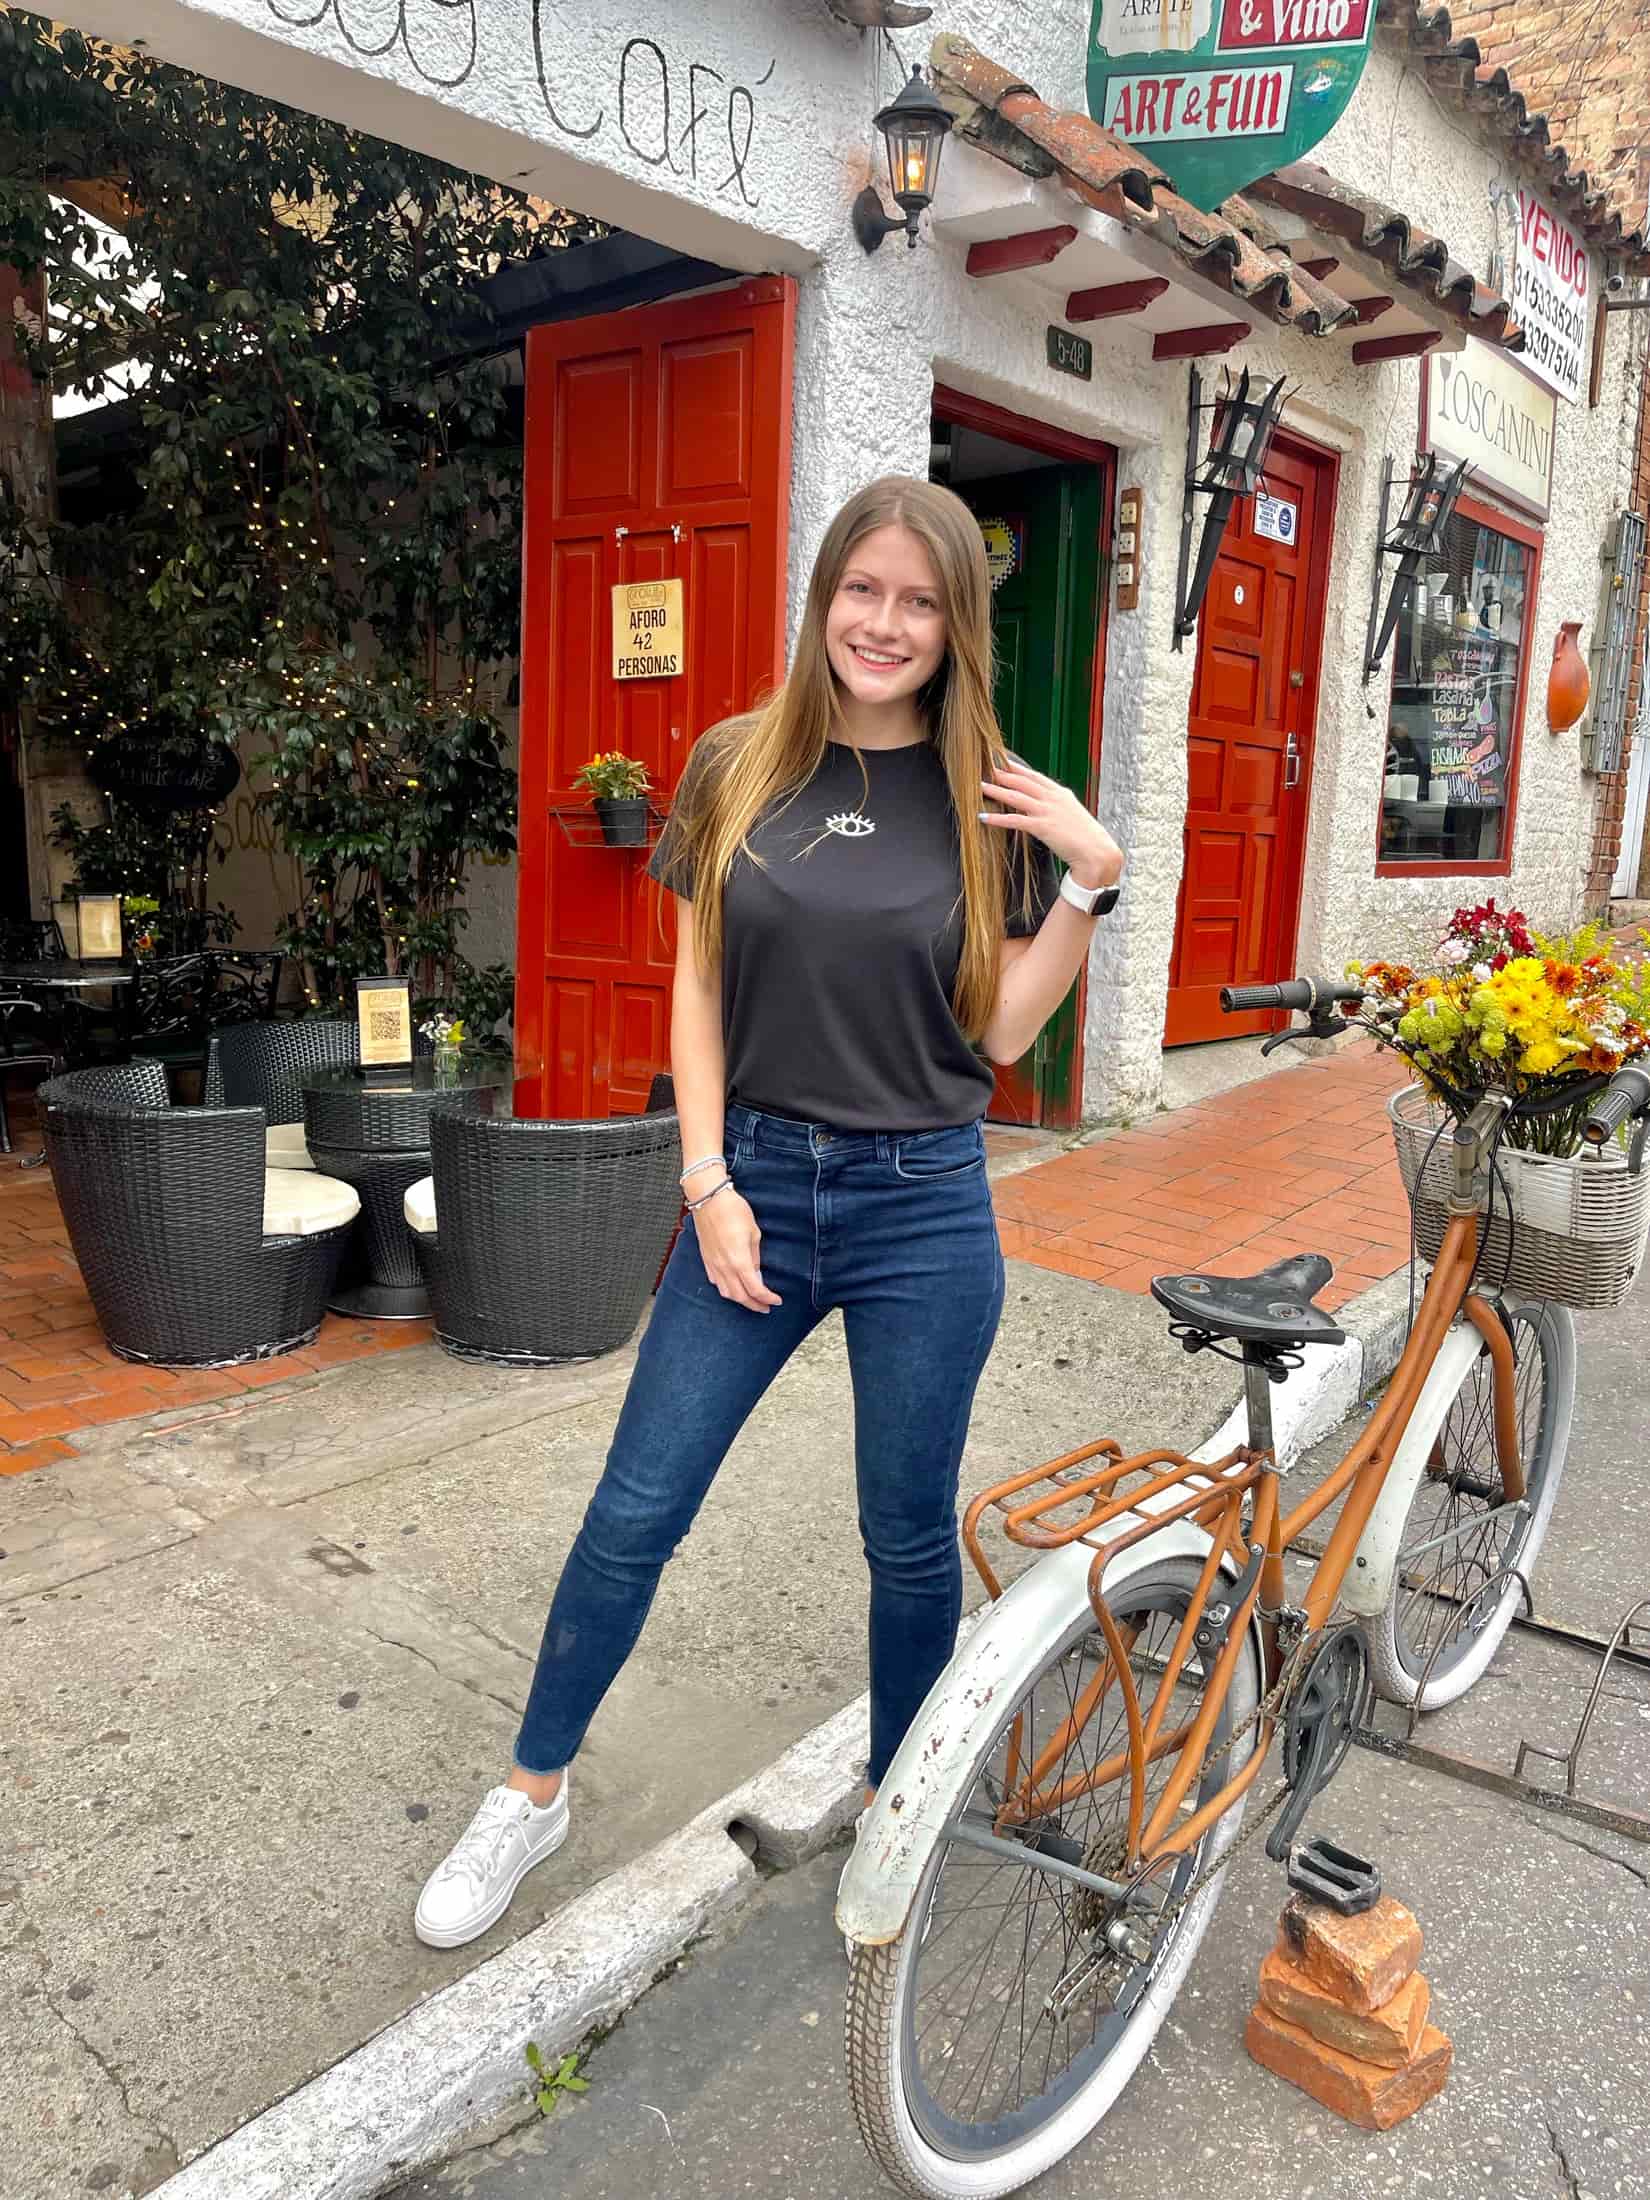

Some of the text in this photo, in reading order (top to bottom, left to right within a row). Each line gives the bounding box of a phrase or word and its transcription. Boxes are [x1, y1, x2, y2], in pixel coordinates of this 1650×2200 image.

[1519, 189, 1587, 298] VENDO
[1514, 263, 1585, 350] 3153335200
[1056, 333, 1086, 373] 5-48
[630, 608, 666, 630] AFORO
[633, 632, 652, 650] 42
[618, 654, 677, 677] PERSONAS
